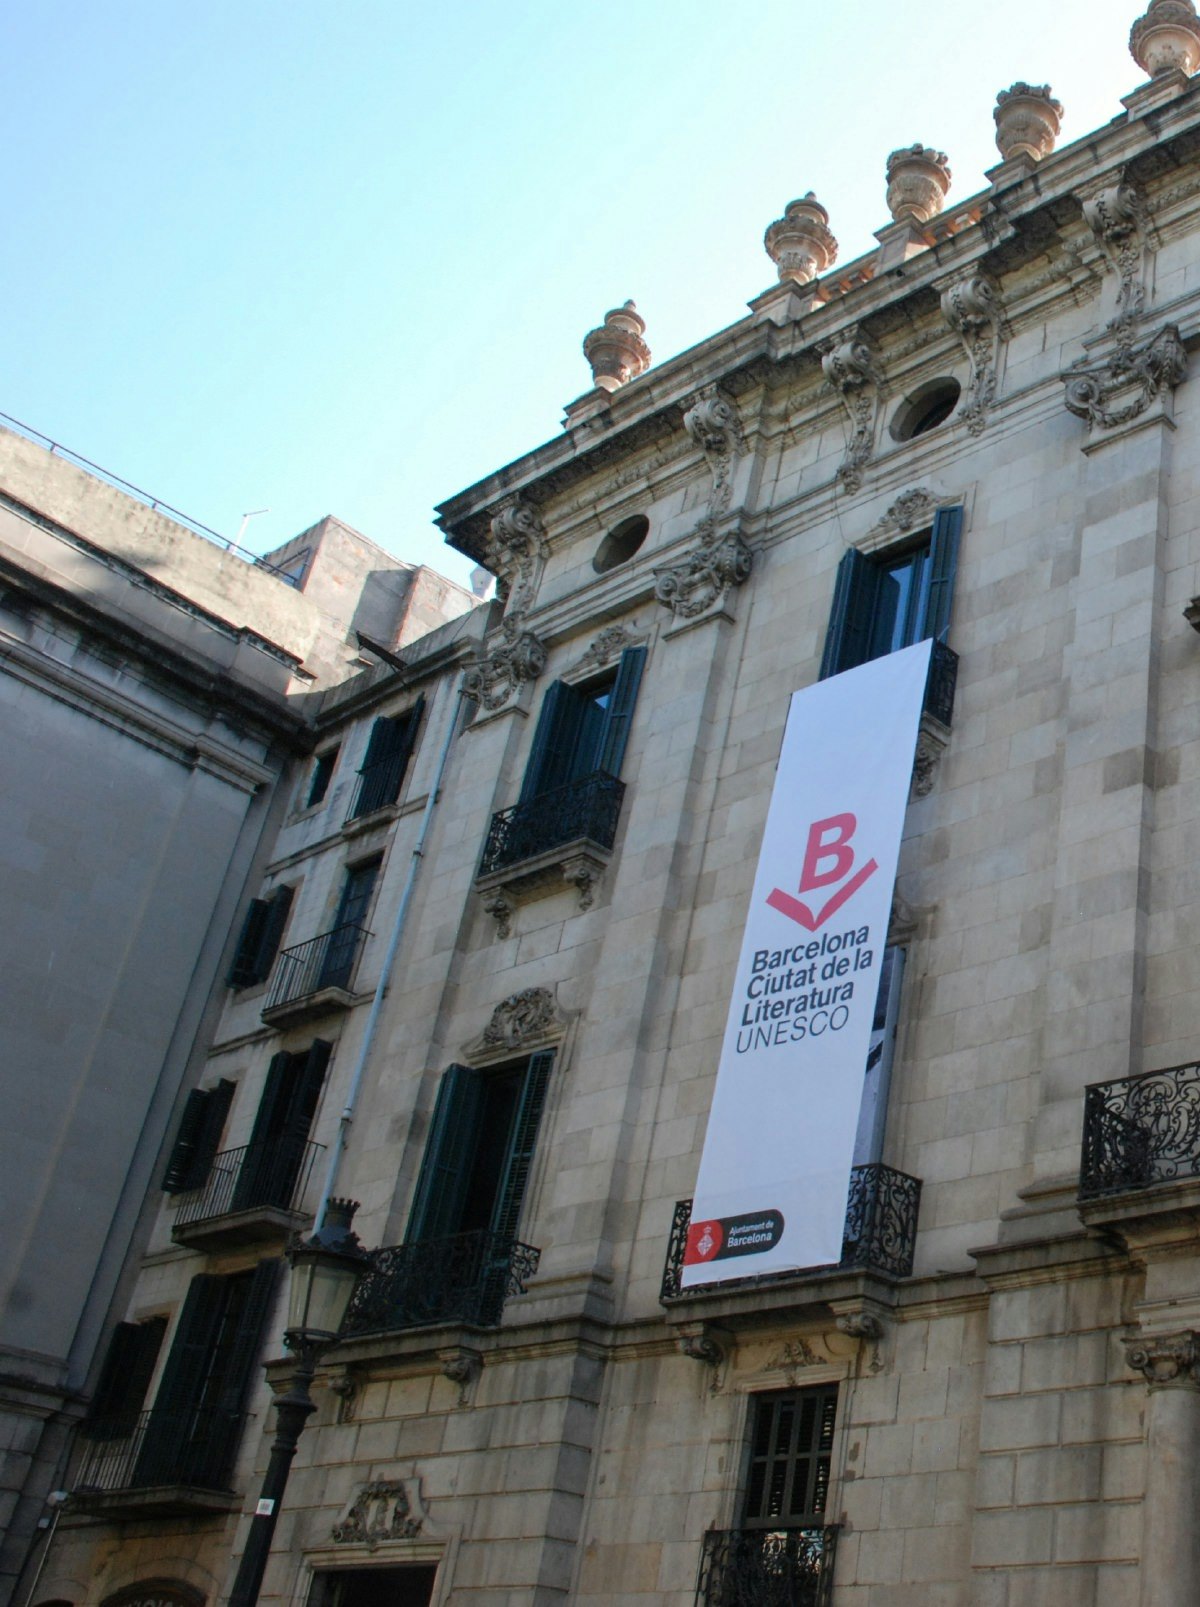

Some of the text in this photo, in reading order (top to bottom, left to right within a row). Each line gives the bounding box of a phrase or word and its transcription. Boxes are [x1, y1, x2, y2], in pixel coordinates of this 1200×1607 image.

[799, 812, 857, 894] B
[747, 947, 873, 999] Ciutat de la
[752, 925, 870, 974] Barcelona
[742, 981, 854, 1027] Literatura
[736, 1004, 849, 1054] UNESCO
[727, 1232, 773, 1247] Barcelona
[729, 1220, 774, 1236] Ajuntament de
